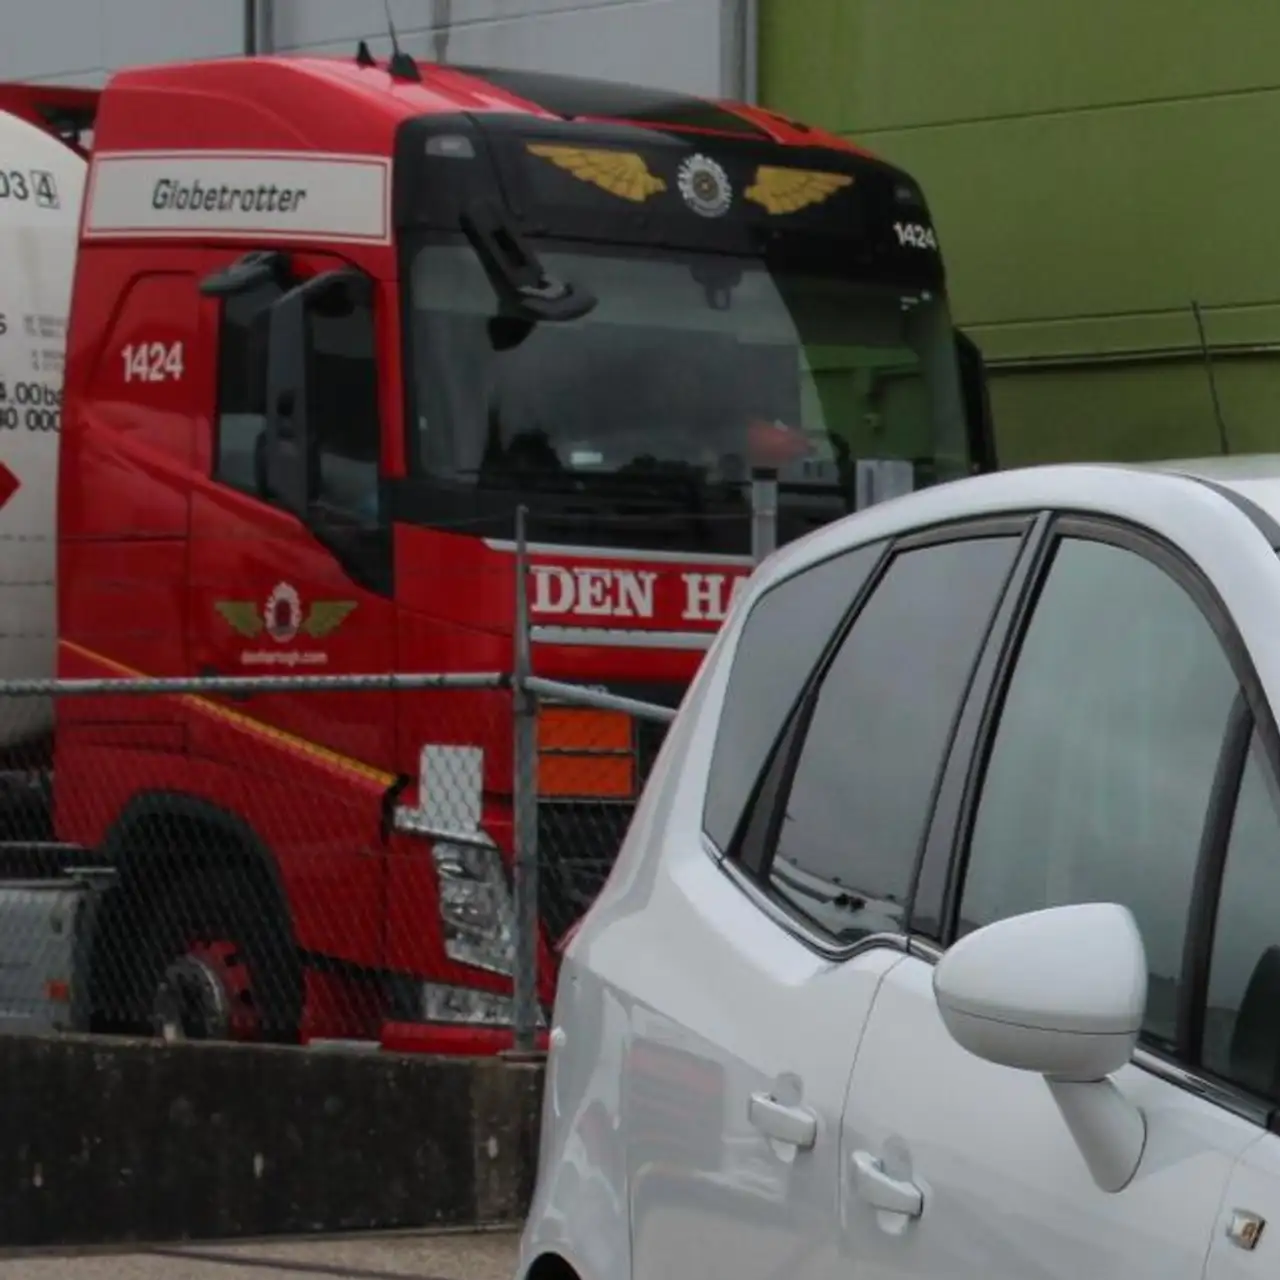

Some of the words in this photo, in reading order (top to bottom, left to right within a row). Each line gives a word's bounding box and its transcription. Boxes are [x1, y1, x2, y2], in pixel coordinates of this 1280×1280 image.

[152, 178, 307, 212] Globetrotter
[893, 221, 937, 249] 1424
[121, 341, 184, 382] 1424
[530, 565, 657, 618] DEN
